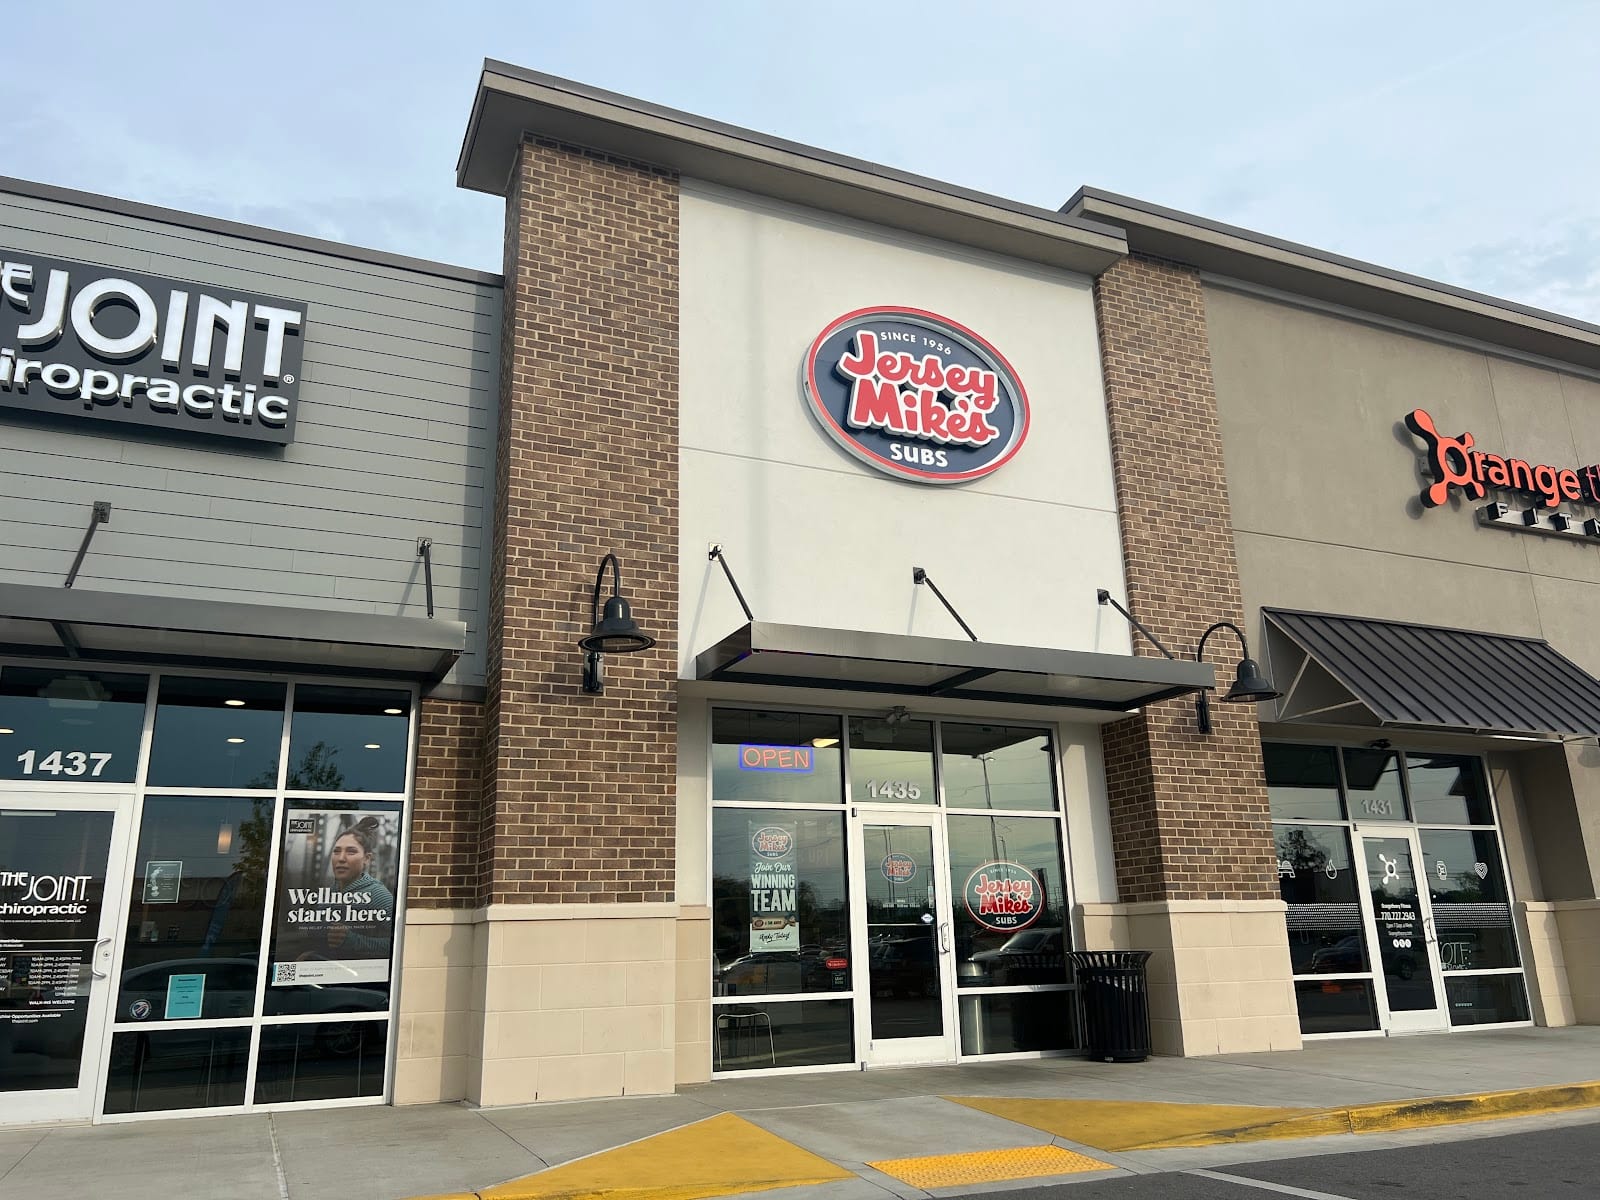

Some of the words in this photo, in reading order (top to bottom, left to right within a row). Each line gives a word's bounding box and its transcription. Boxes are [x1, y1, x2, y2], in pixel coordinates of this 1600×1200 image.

[0, 261, 33, 308] E
[880, 331, 917, 343] SINCE
[922, 337, 952, 355] 1956
[838, 331, 998, 411] Jersey
[849, 377, 999, 444] Mike's
[889, 443, 949, 468] SUBS
[16, 749, 113, 776] 1437
[743, 747, 810, 768] OPEN
[865, 779, 921, 800] 1435
[1360, 799, 1393, 815] 1431
[757, 832, 788, 847] Jersey
[754, 862, 774, 874] Join
[774, 862, 792, 873] Our
[0, 871, 29, 887] THE
[751, 874, 796, 889] WINNING
[975, 873, 1033, 900] Jersey
[287, 887, 372, 905] Wellness
[751, 889, 796, 912] TEAM
[979, 893, 1034, 915] Mike's
[287, 906, 341, 923] starts
[344, 904, 392, 922] here.
[995, 916, 1018, 925] SUBS
